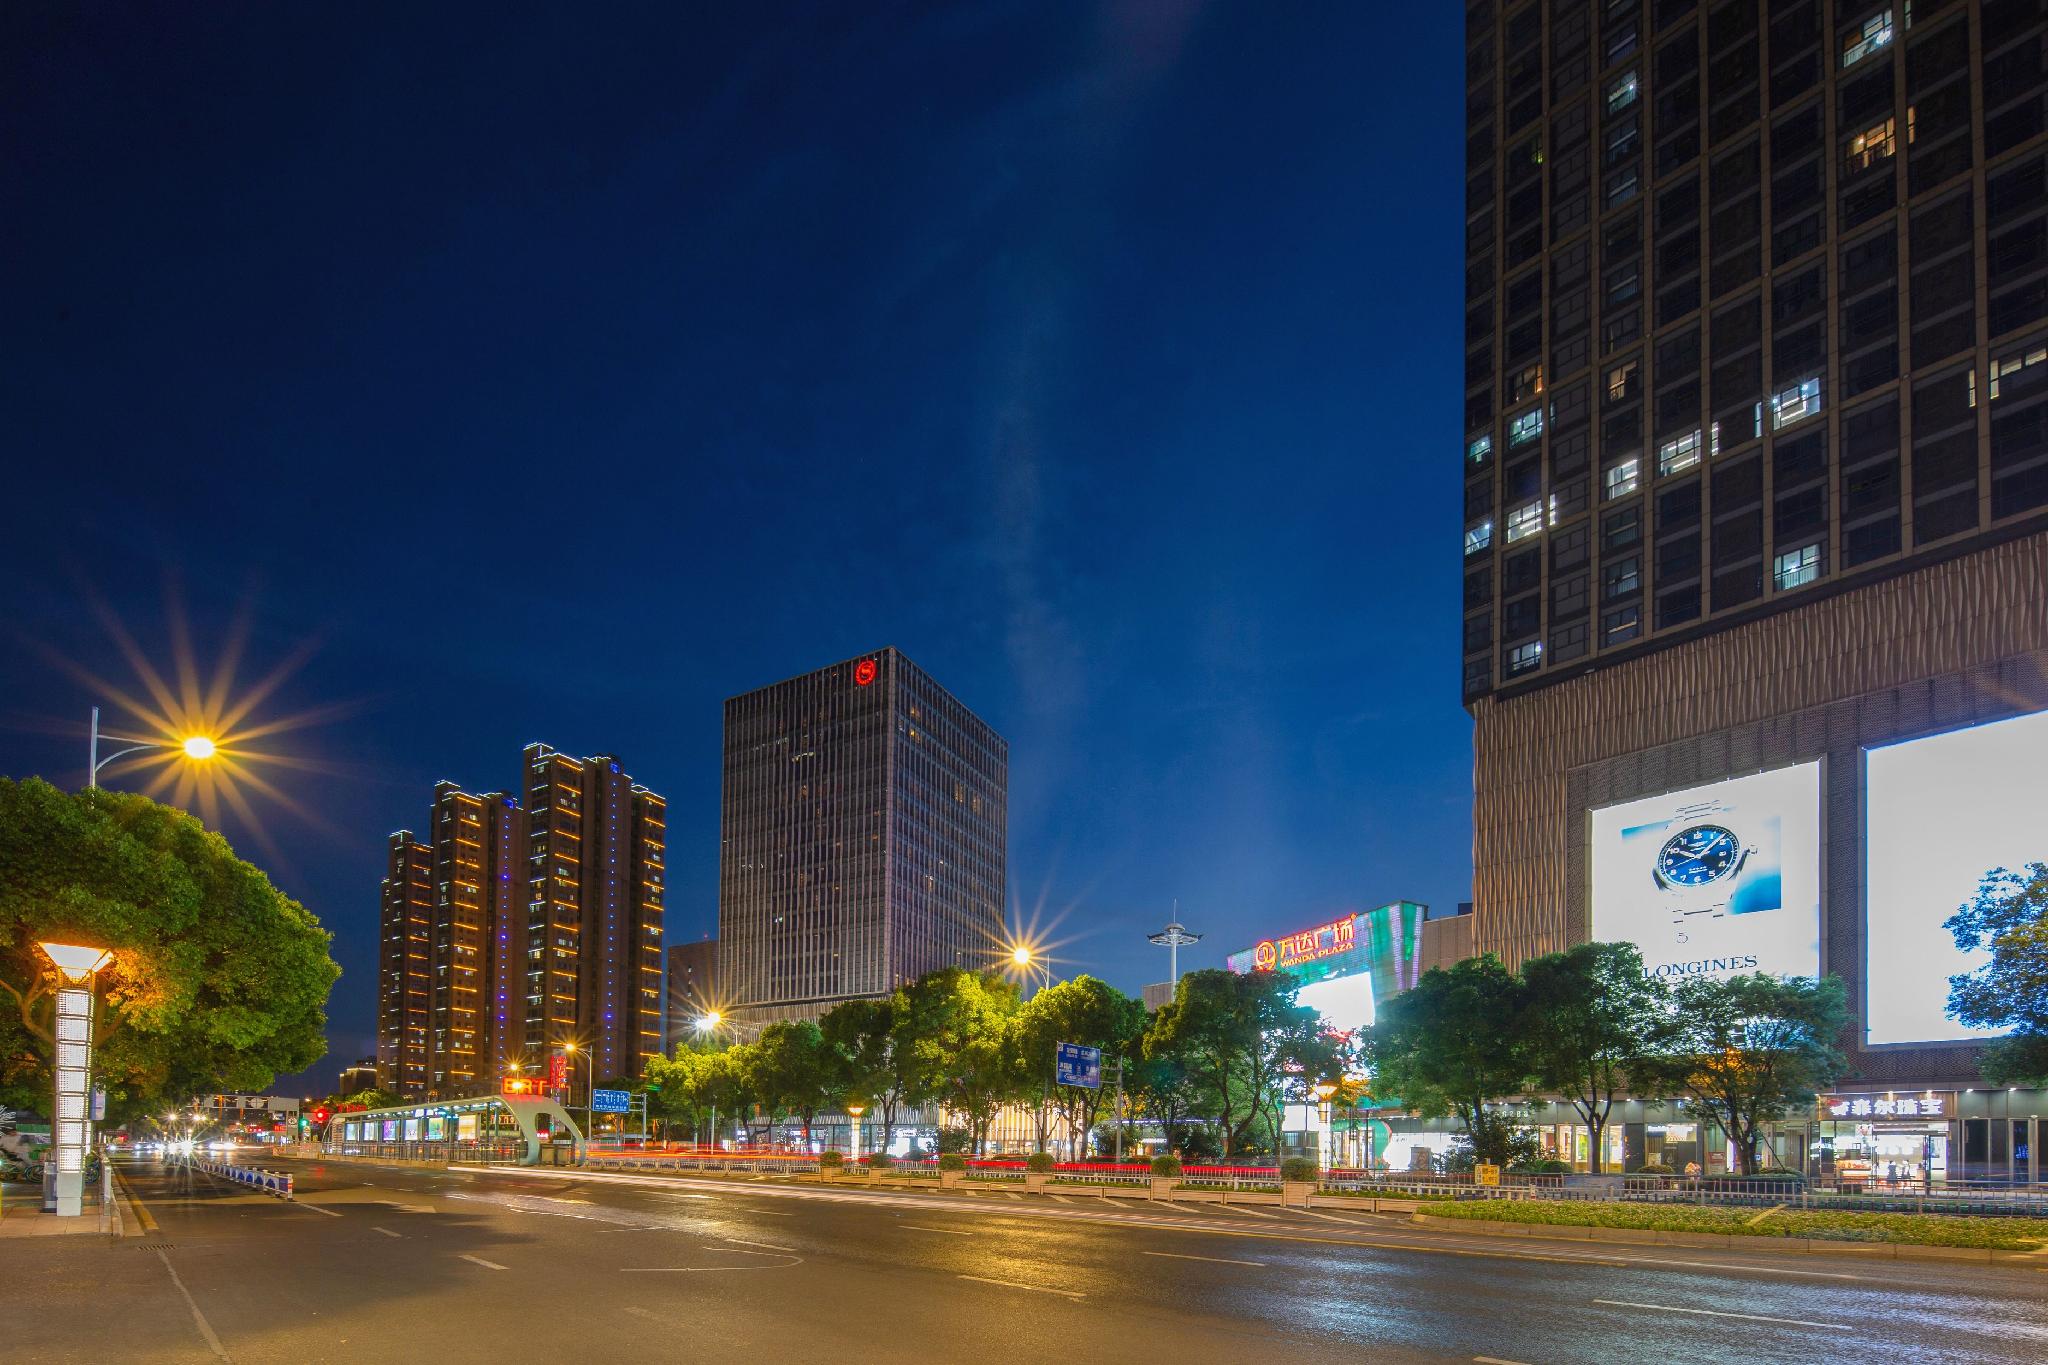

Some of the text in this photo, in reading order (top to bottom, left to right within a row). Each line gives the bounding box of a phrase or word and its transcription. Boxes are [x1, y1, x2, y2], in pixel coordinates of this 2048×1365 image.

[1708, 870, 1716, 878] 5
[1719, 860, 1727, 868] 4
[1278, 918, 1355, 959] 万达广场
[1280, 941, 1355, 968] WANDA PLAZA
[1642, 954, 1758, 979] LONGINES
[503, 1078, 548, 1095] BRT
